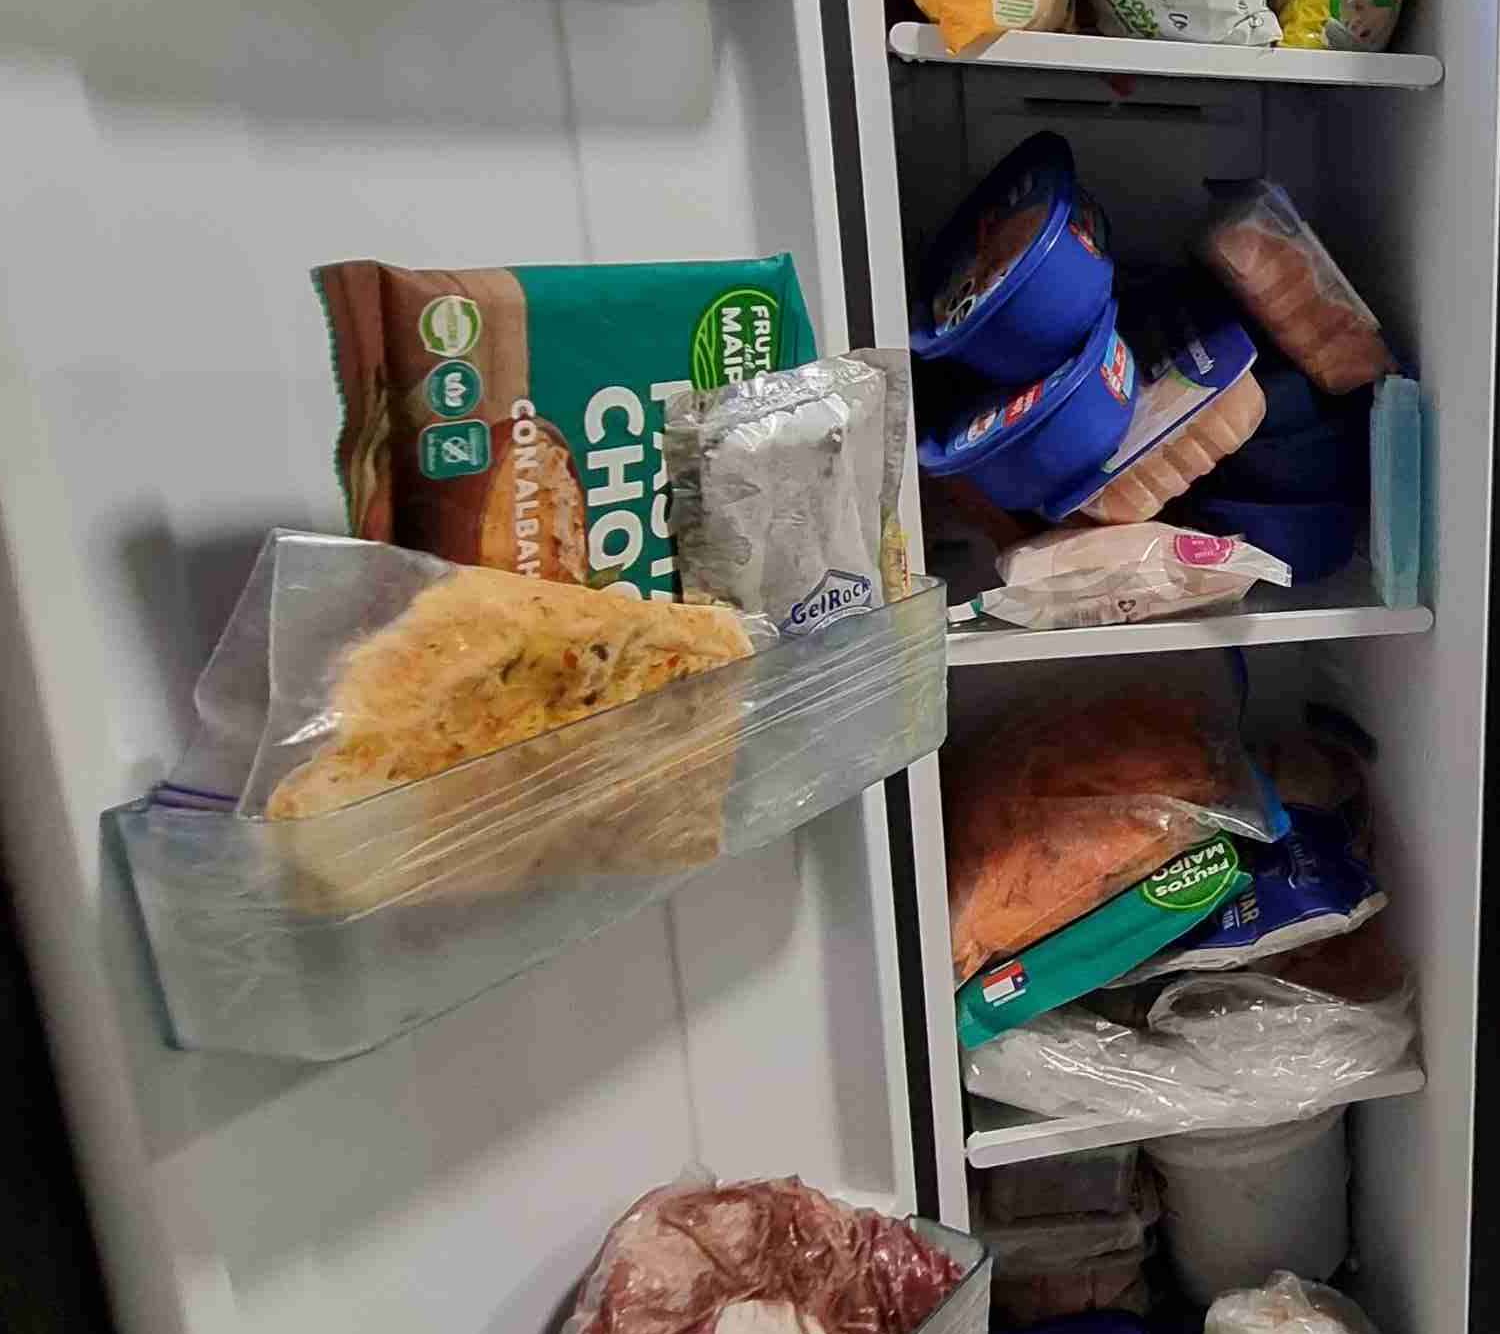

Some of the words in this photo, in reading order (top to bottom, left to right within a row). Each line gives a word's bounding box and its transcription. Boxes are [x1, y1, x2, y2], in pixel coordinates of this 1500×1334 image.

[511, 398, 537, 471] CON
[584, 385, 645, 599] CHO
[1151, 842, 1226, 882] MAIPO
[1154, 858, 1230, 897] FRUTOS
